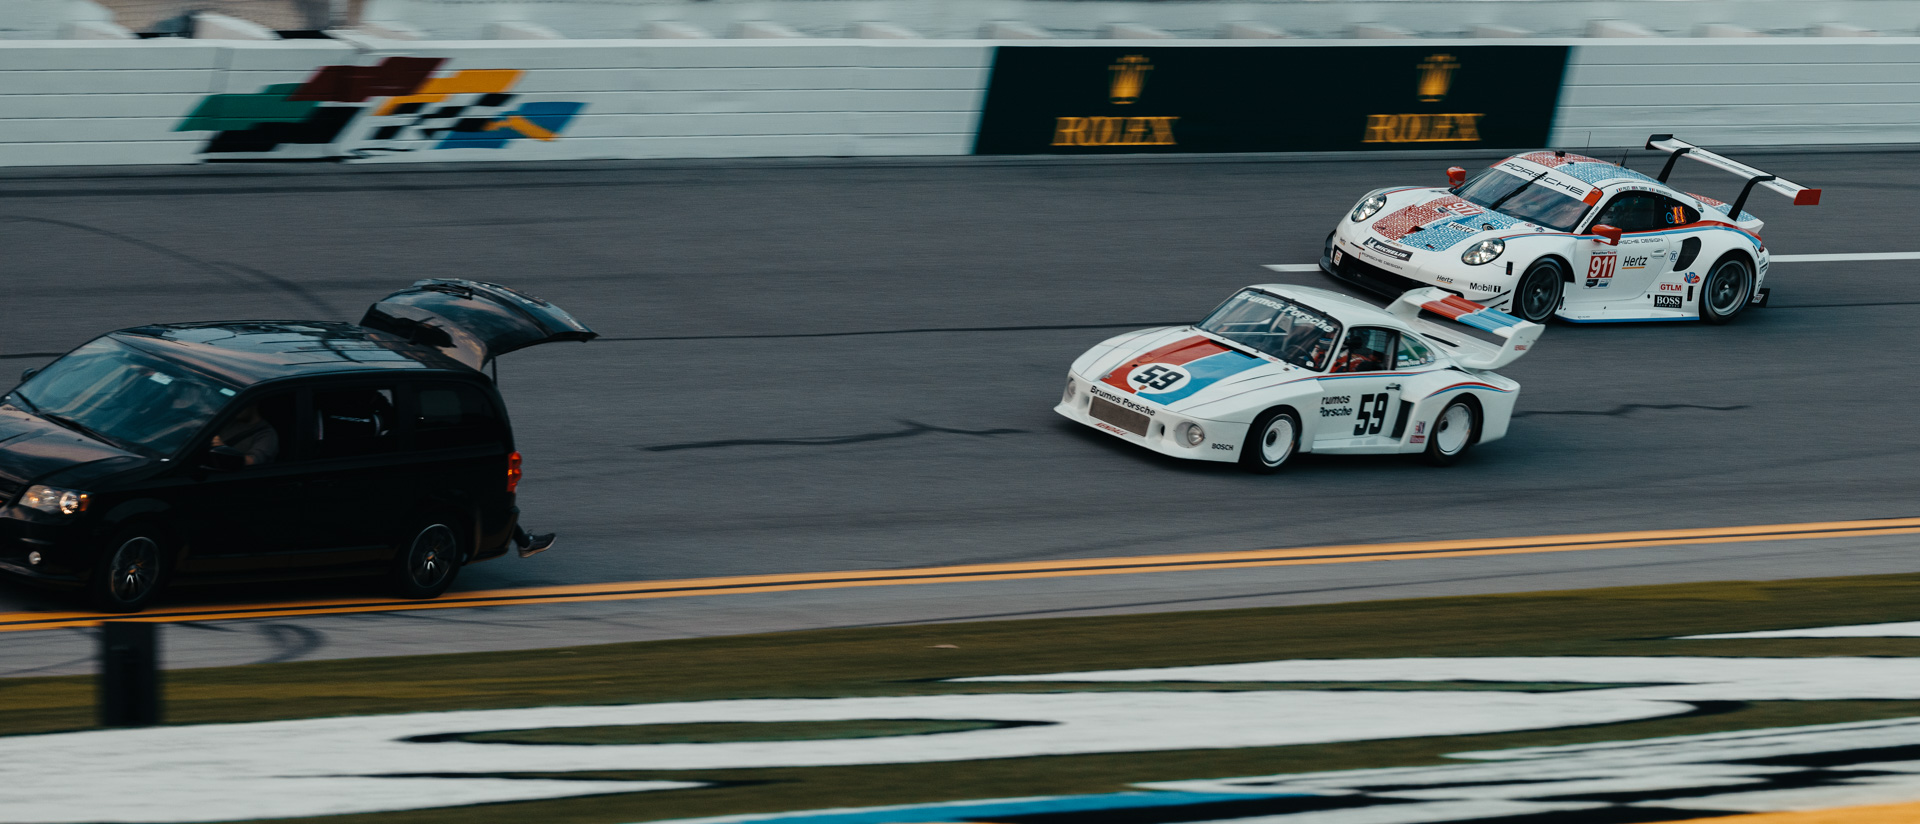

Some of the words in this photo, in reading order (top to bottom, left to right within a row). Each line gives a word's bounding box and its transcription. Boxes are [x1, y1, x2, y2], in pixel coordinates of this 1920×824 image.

[1050, 116, 1180, 146] ROLEX
[1361, 113, 1484, 142] ROLEX
[1502, 162, 1584, 196] PORSCHE
[1447, 203, 1481, 215] 911
[1448, 222, 1475, 234] Hertz
[1375, 244, 1407, 258] MICHELIN
[1590, 256, 1615, 277] 911
[1622, 256, 1648, 266] Hertz
[1436, 274, 1454, 283] Hertz
[1685, 272, 1695, 284] VP
[1469, 282, 1493, 292] Mobil
[1656, 295, 1680, 305] BOSS
[1236, 292, 1284, 310] Brumos
[1281, 305, 1334, 333] Porsche
[1133, 365, 1184, 391] 59
[1090, 385, 1122, 404] Brumos
[1122, 398, 1156, 416] Porsche
[1353, 392, 1389, 436] 59
[1211, 442, 1234, 451] BOSCH
